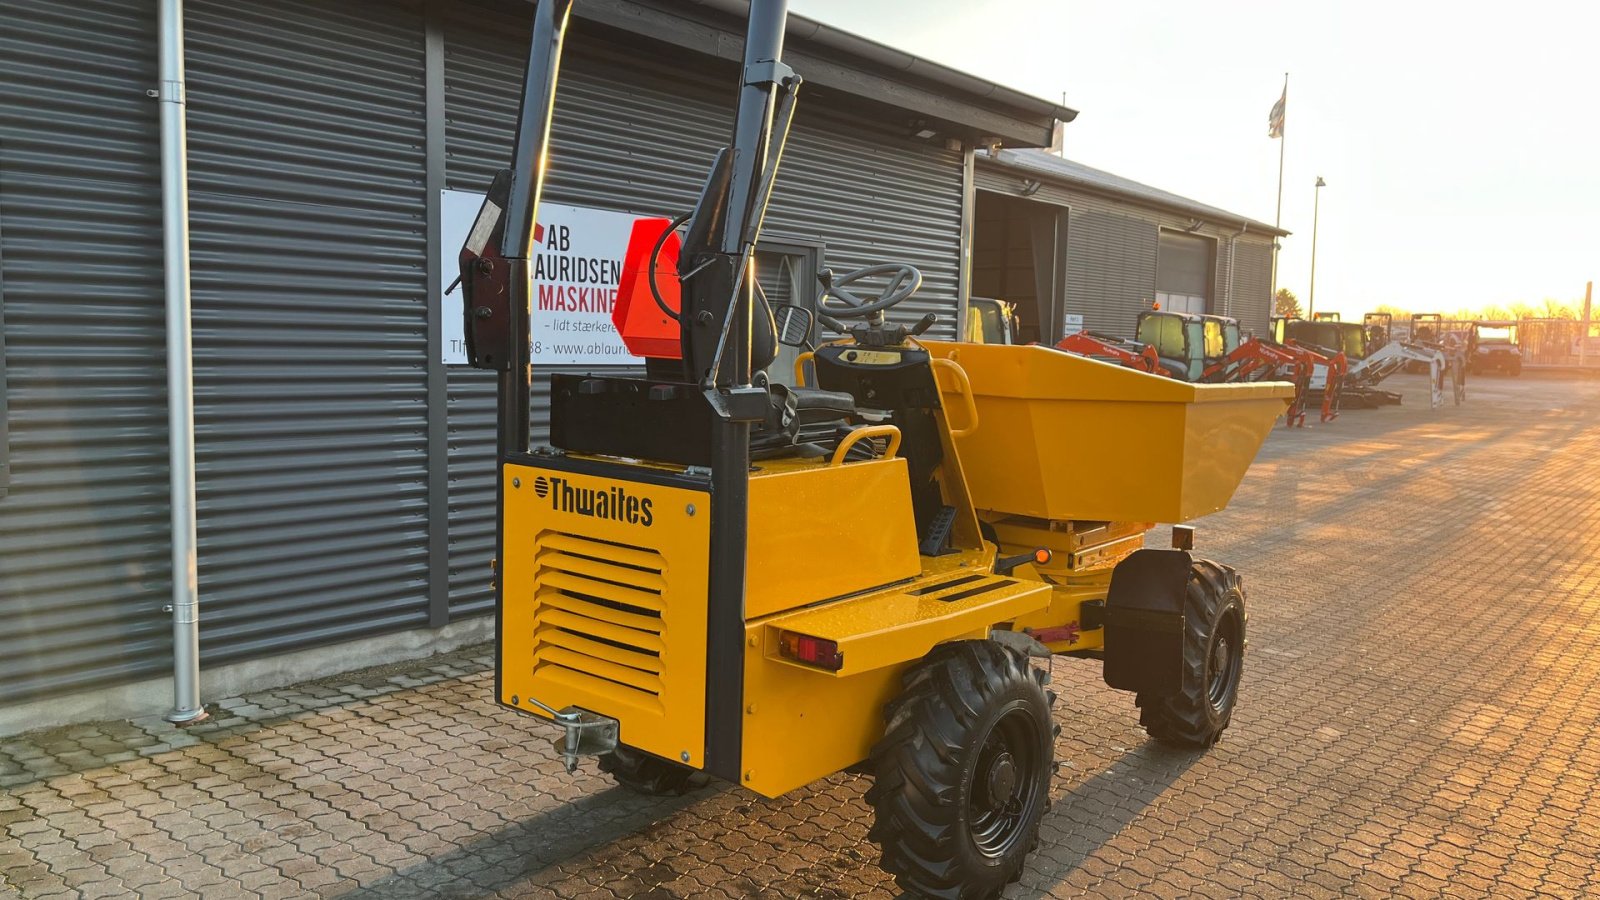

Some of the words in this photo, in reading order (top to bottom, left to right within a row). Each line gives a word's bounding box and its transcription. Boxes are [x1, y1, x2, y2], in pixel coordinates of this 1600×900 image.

[547, 224, 570, 252] AB
[531, 253, 621, 285] AURIDSEN
[553, 319, 569, 332] lidt
[550, 477, 653, 527] Thwaites
